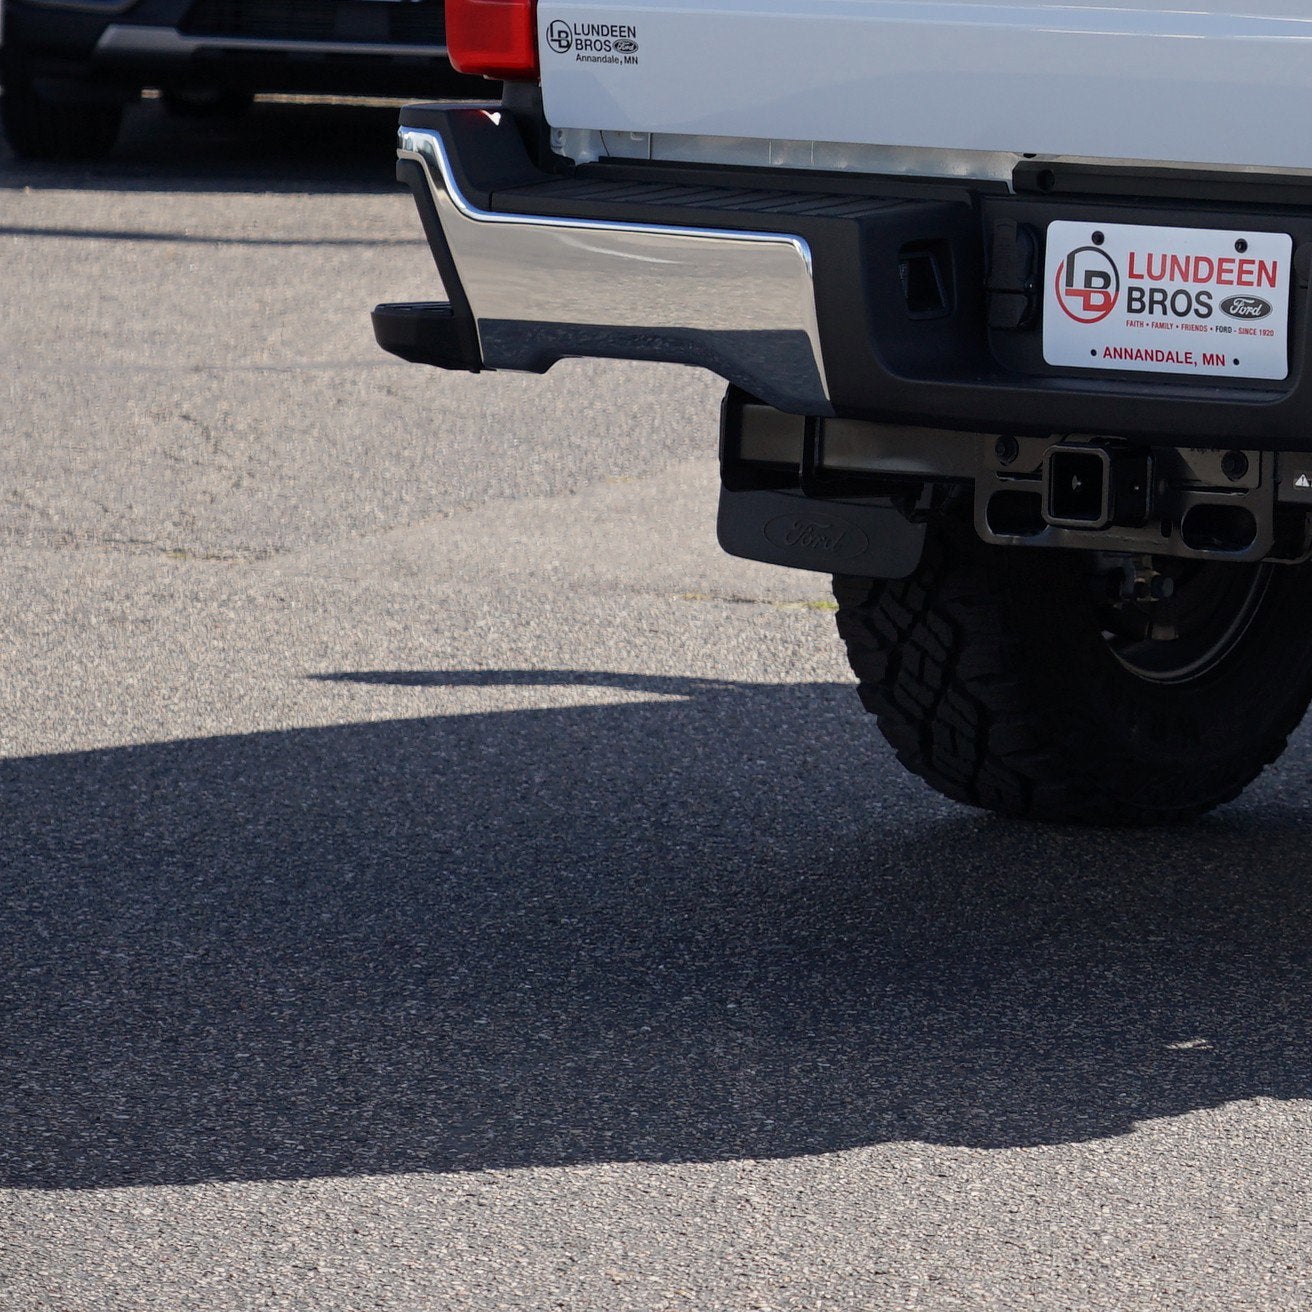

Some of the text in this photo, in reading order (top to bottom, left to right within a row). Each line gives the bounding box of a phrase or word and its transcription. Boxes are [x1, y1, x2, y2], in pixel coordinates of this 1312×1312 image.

[573, 22, 637, 39] LUNDEEN
[575, 38, 612, 52] BROS
[576, 53, 639, 66] Annandale, MN
[1127, 251, 1279, 289] LUNDEEN
[1126, 285, 1214, 319] BROS
[1228, 297, 1263, 318] Ford
[1125, 319, 1275, 337] FAITH FAMILY FRIENDS FORD SINCE 1920
[1102, 346, 1226, 368] ANNANDALE, MN
[784, 517, 849, 550] Ford
